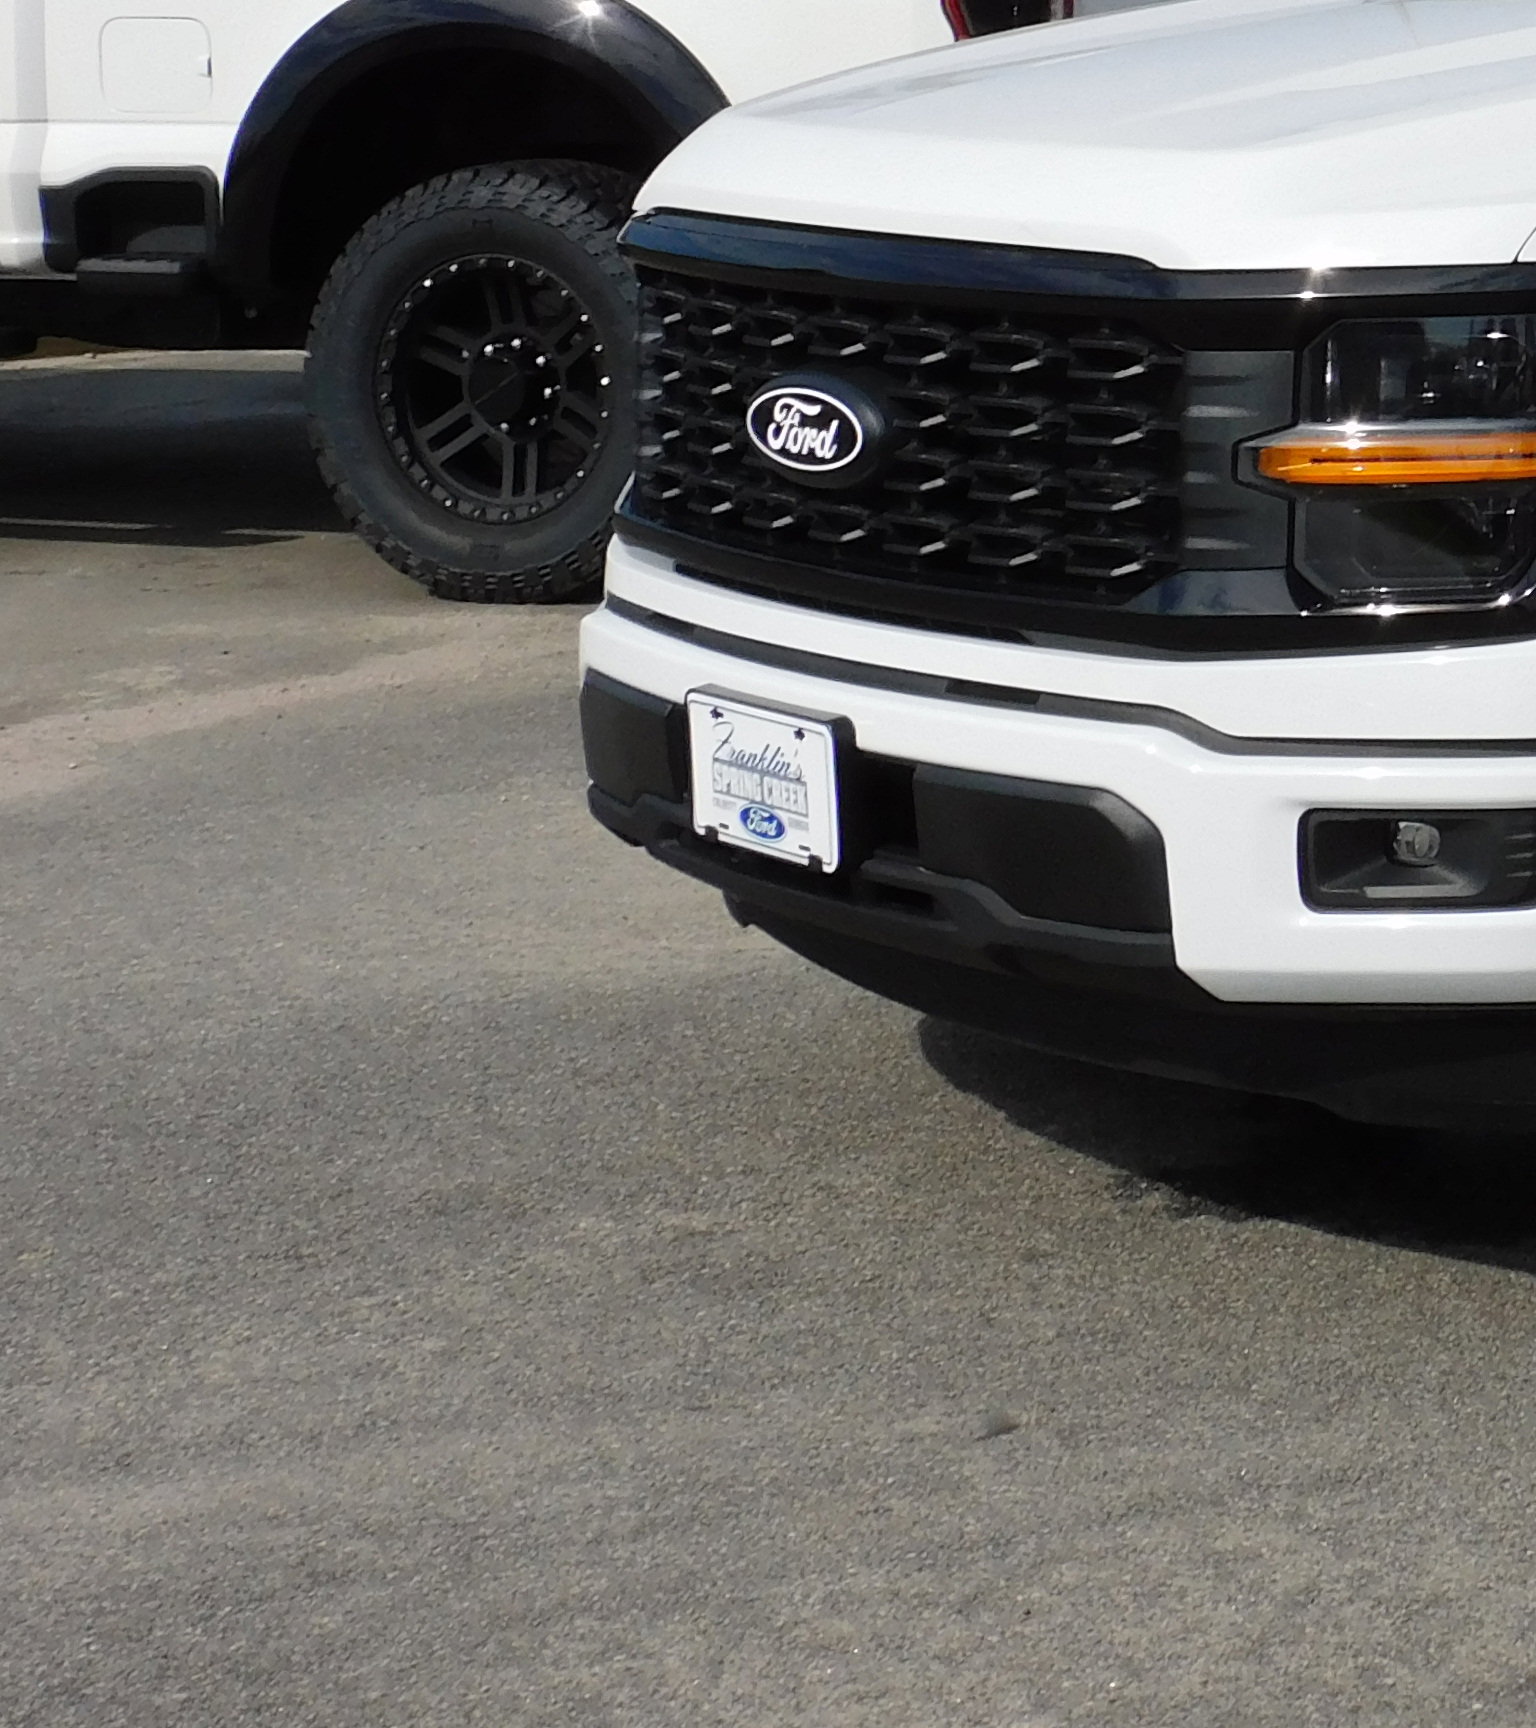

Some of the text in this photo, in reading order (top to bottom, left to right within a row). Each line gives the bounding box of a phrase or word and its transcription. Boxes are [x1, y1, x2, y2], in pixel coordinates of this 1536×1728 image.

[766, 397, 840, 460] Ford
[713, 763, 807, 816] SPRING CREEK
[746, 807, 778, 836] Ford
